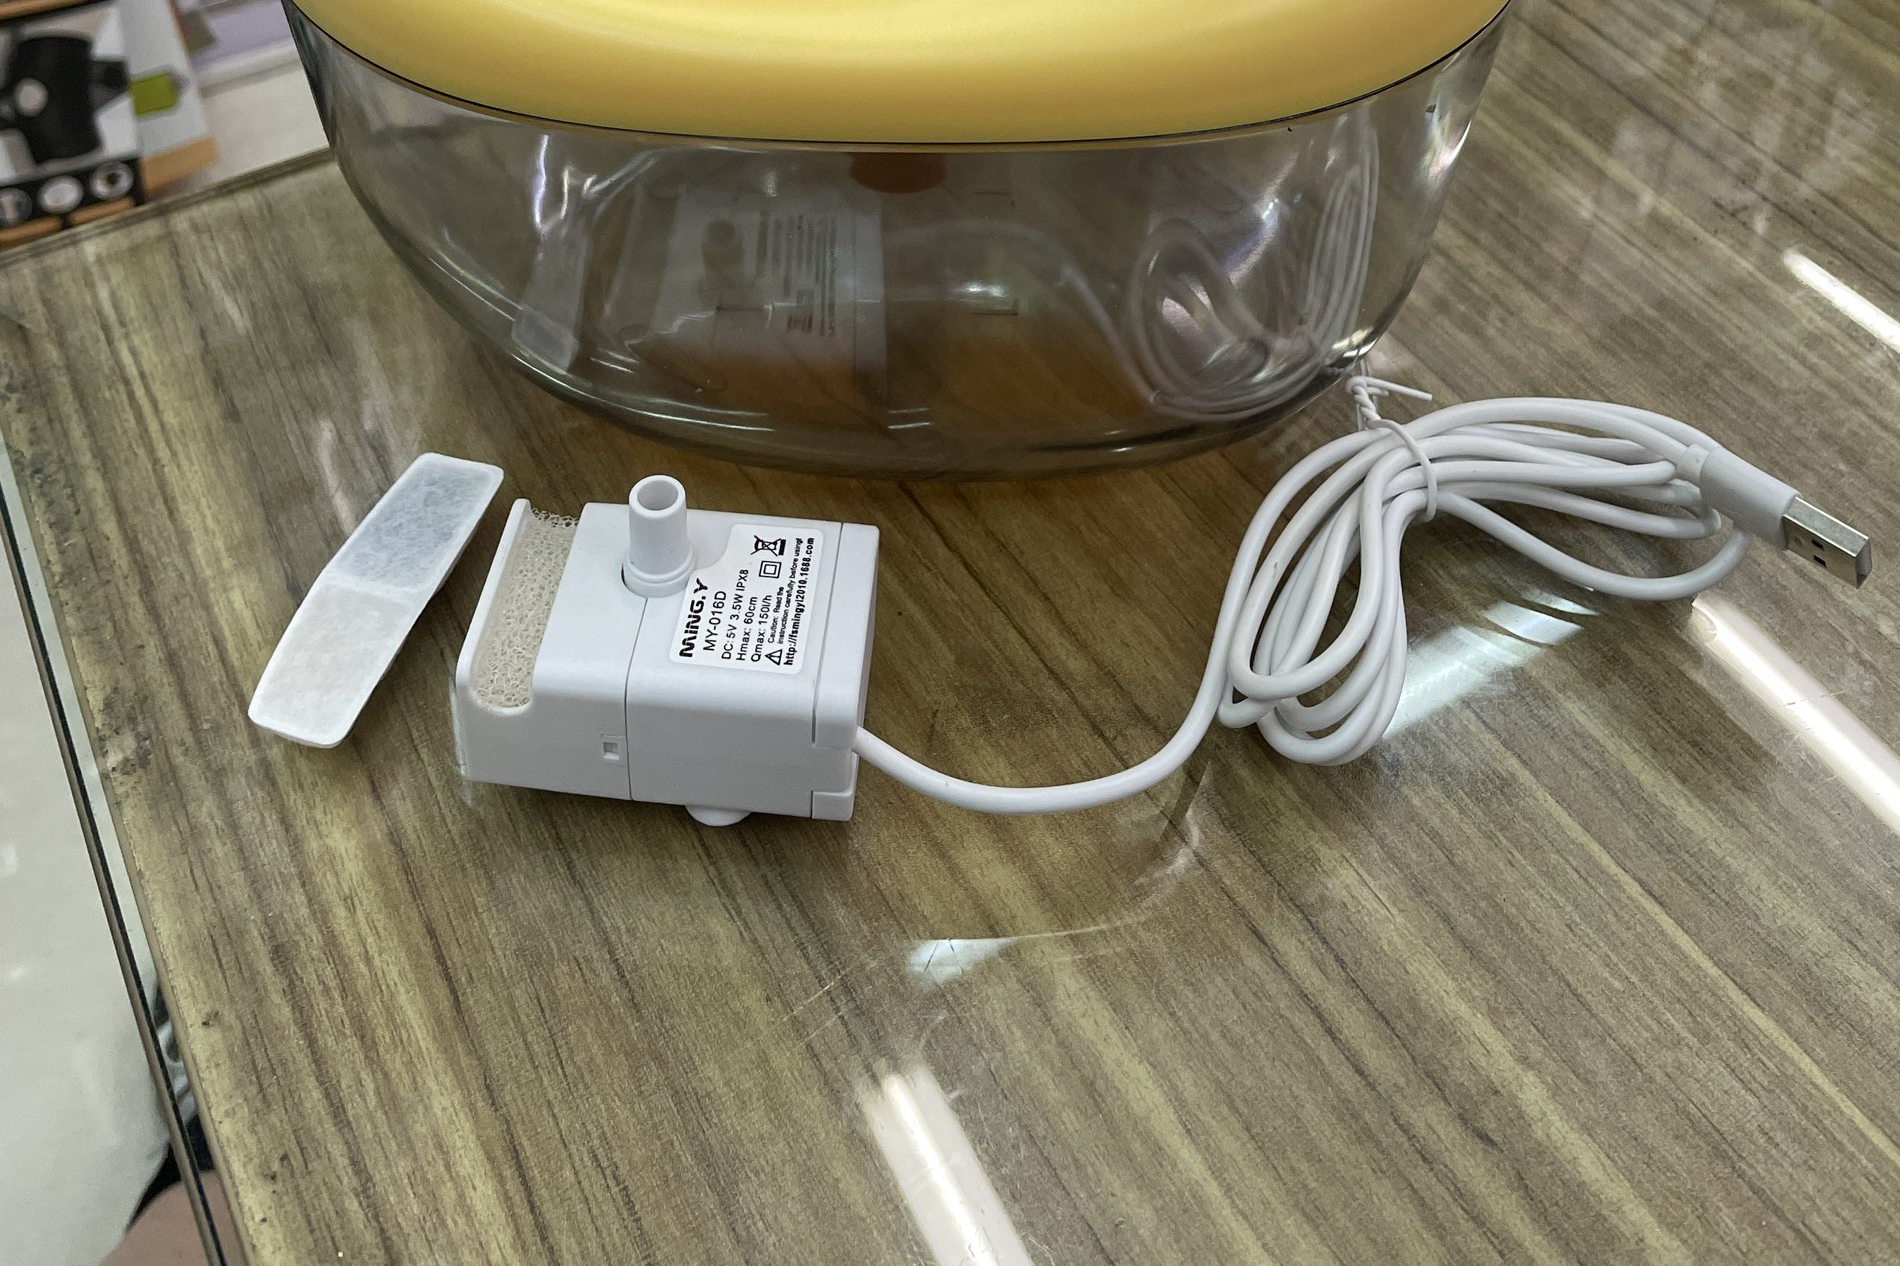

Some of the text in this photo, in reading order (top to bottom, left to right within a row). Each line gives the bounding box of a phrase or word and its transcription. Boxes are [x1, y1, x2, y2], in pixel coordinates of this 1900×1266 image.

[735, 569, 749, 591] IPX8
[789, 558, 799, 578] before
[729, 594, 744, 621] 3.5W
[784, 580, 796, 608] carefully
[703, 591, 727, 651] MY-016D
[736, 596, 758, 661] Hmax: 60cm
[767, 587, 784, 643] Caution: Read the
[777, 609, 790, 644] instruction
[751, 629, 766, 662] Qmax:
